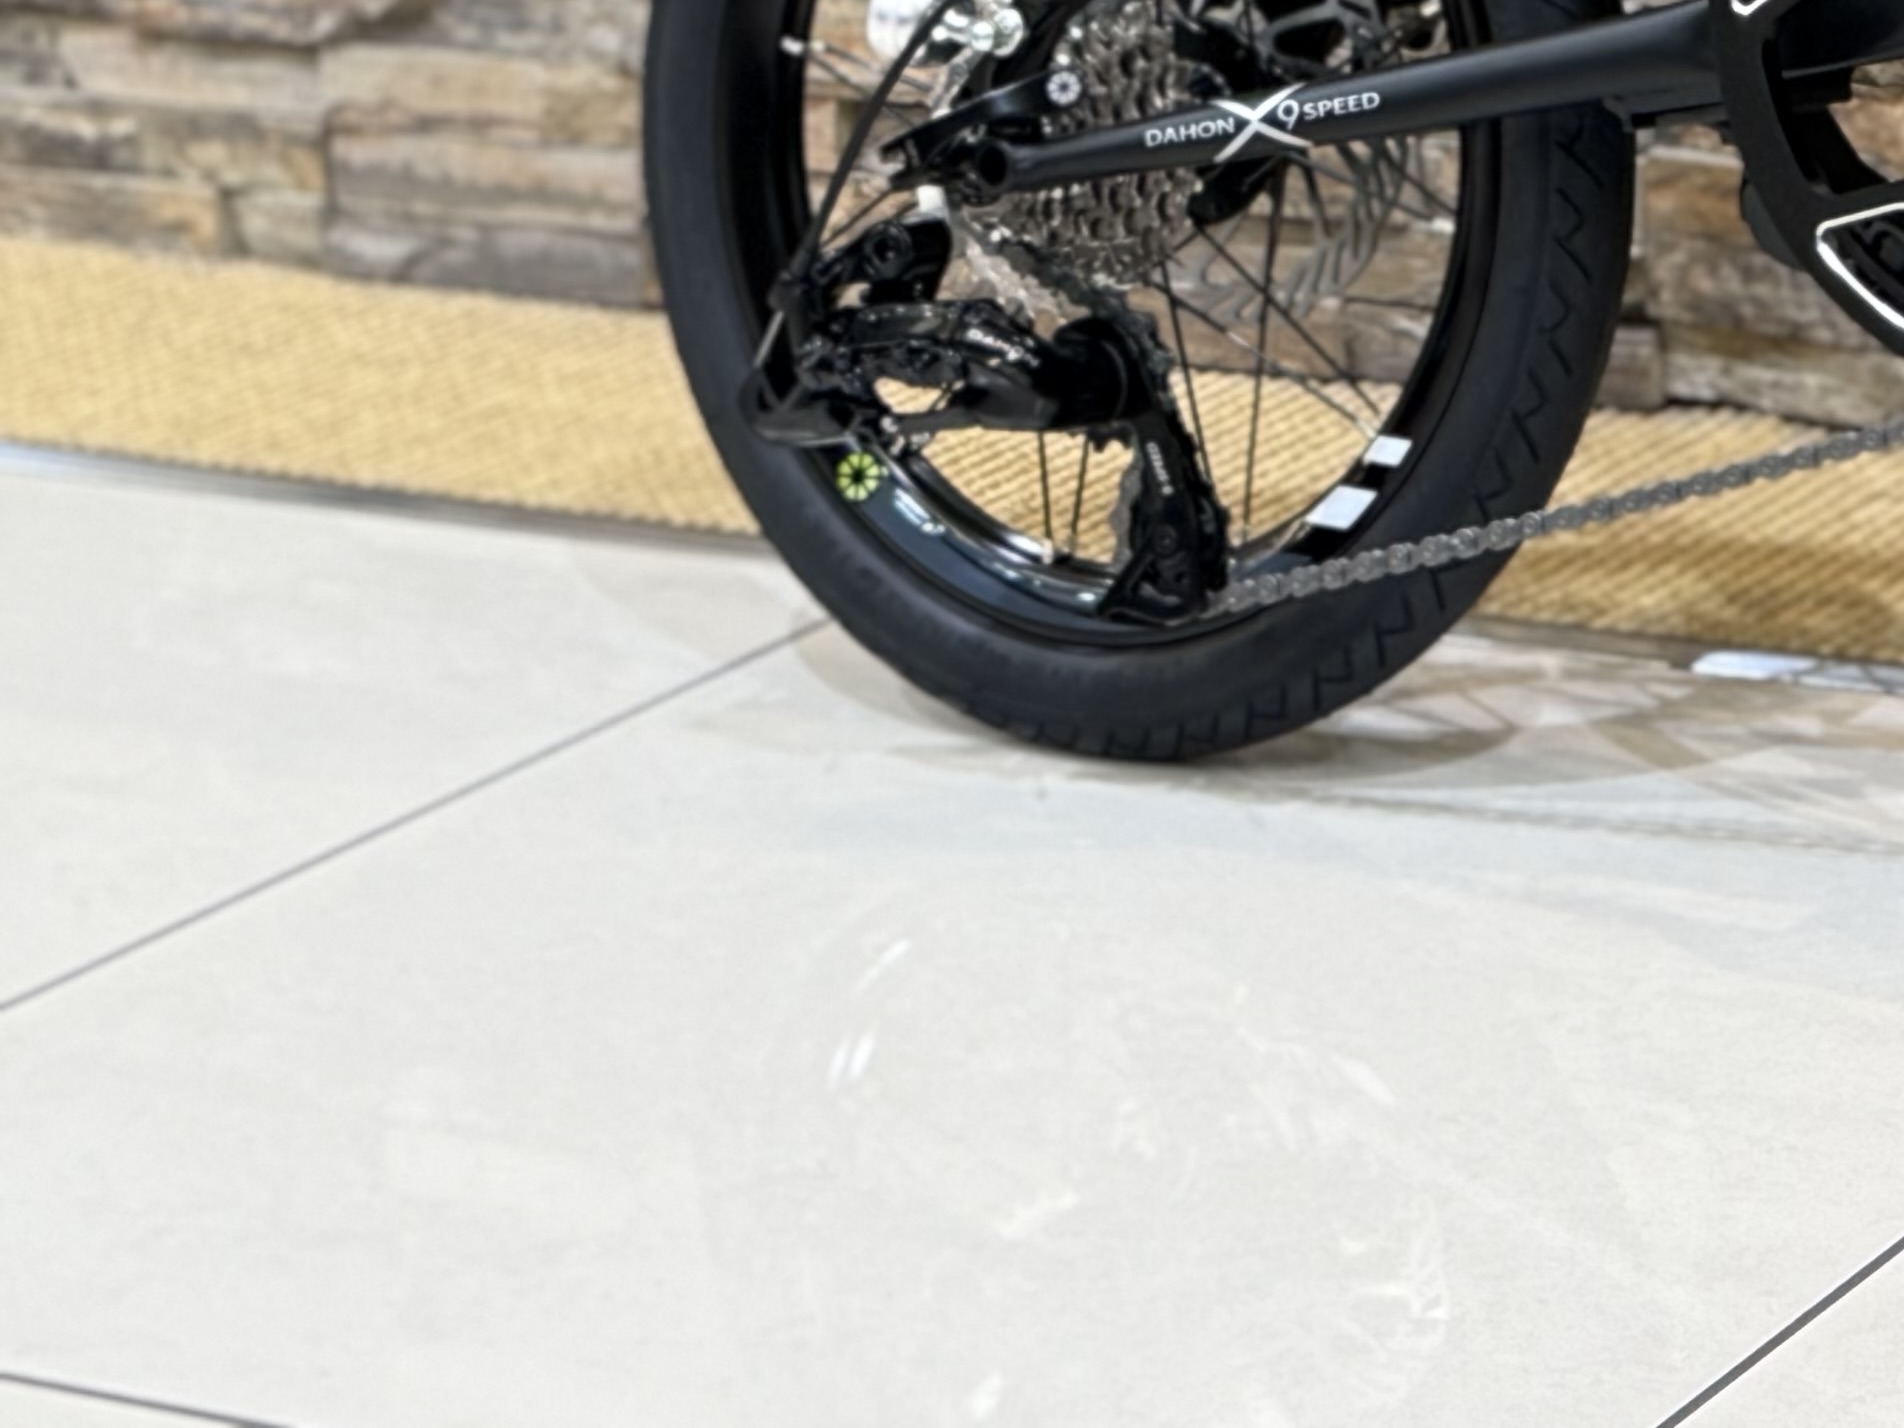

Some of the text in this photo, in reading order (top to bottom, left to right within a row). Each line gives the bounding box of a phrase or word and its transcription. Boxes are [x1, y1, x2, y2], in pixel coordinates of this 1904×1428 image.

[1144, 117, 1235, 148] DAHON
[1276, 99, 1300, 131] 9
[1302, 91, 1381, 121] SPEED
